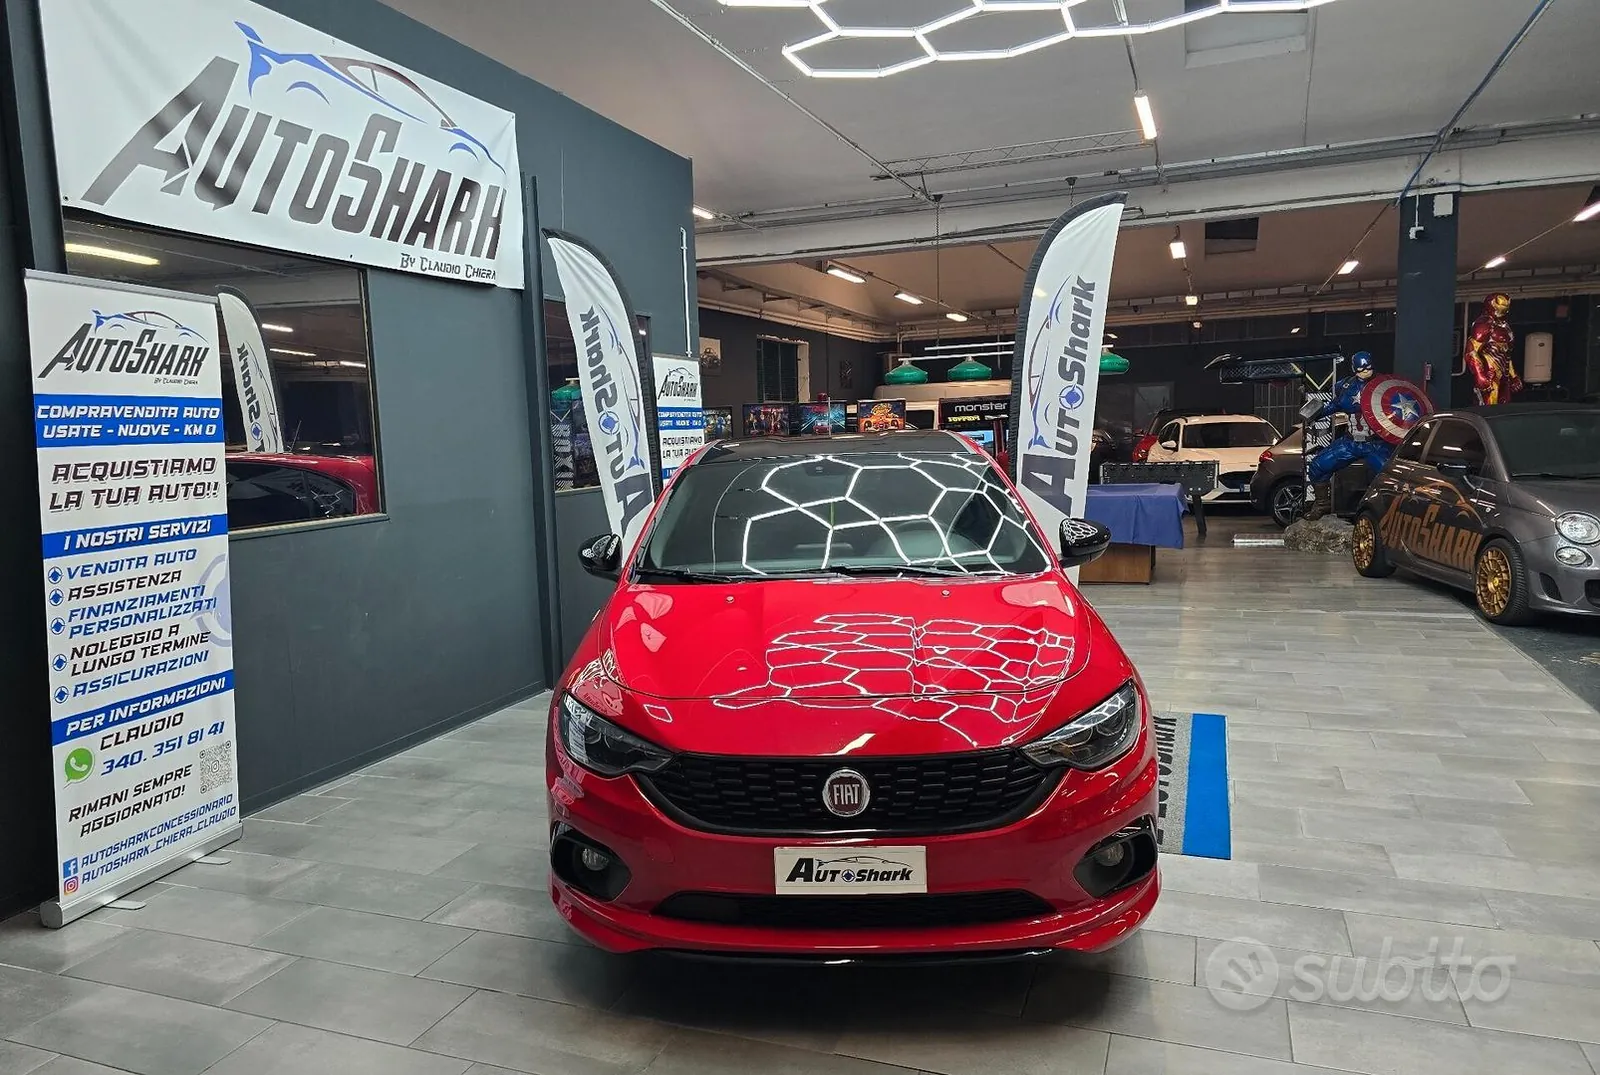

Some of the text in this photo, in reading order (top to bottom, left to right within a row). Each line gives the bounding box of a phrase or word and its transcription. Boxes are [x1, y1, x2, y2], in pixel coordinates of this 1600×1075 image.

[37, 404, 221, 420] COMPRAVENDITA AUTO
[954, 402, 1009, 413] monster
[43, 424, 102, 439] USATE
[117, 424, 170, 437] NUOVE
[183, 424, 202, 437] KM
[51, 457, 217, 483] ACQUISTIAMO
[49, 481, 219, 513] LA TUA AUTO!!
[63, 519, 212, 551] I NOSTRI SERVIZI
[67, 549, 197, 580] VENDITA AUTO
[68, 570, 182, 601] ASSISTENZA
[68, 585, 206, 623] FINANZIAMENTI
[69, 597, 217, 639] PERSONALIZZATI
[70, 624, 180, 660] NOLEGGIO A
[71, 631, 211, 677] LUNGO TERMINE
[72, 650, 209, 698] ASSICURAZIONI
[66, 677, 226, 736] PER INFORMAZIONI
[100, 712, 184, 750] CLAUDIO
[152, 736, 183, 758] 351
[187, 728, 204, 745] 81
[208, 721, 225, 736] 41
[69, 764, 193, 822] RIMANI SEMPRE
[80, 785, 186, 837] AGGIORNATO!
[833, 783, 860, 806] FIAT
[81, 793, 233, 868] AUTOSHARKCONCESSIONARIO
[81, 806, 236, 884] AUTOSHARK_CHIERA_CLAUDIO
